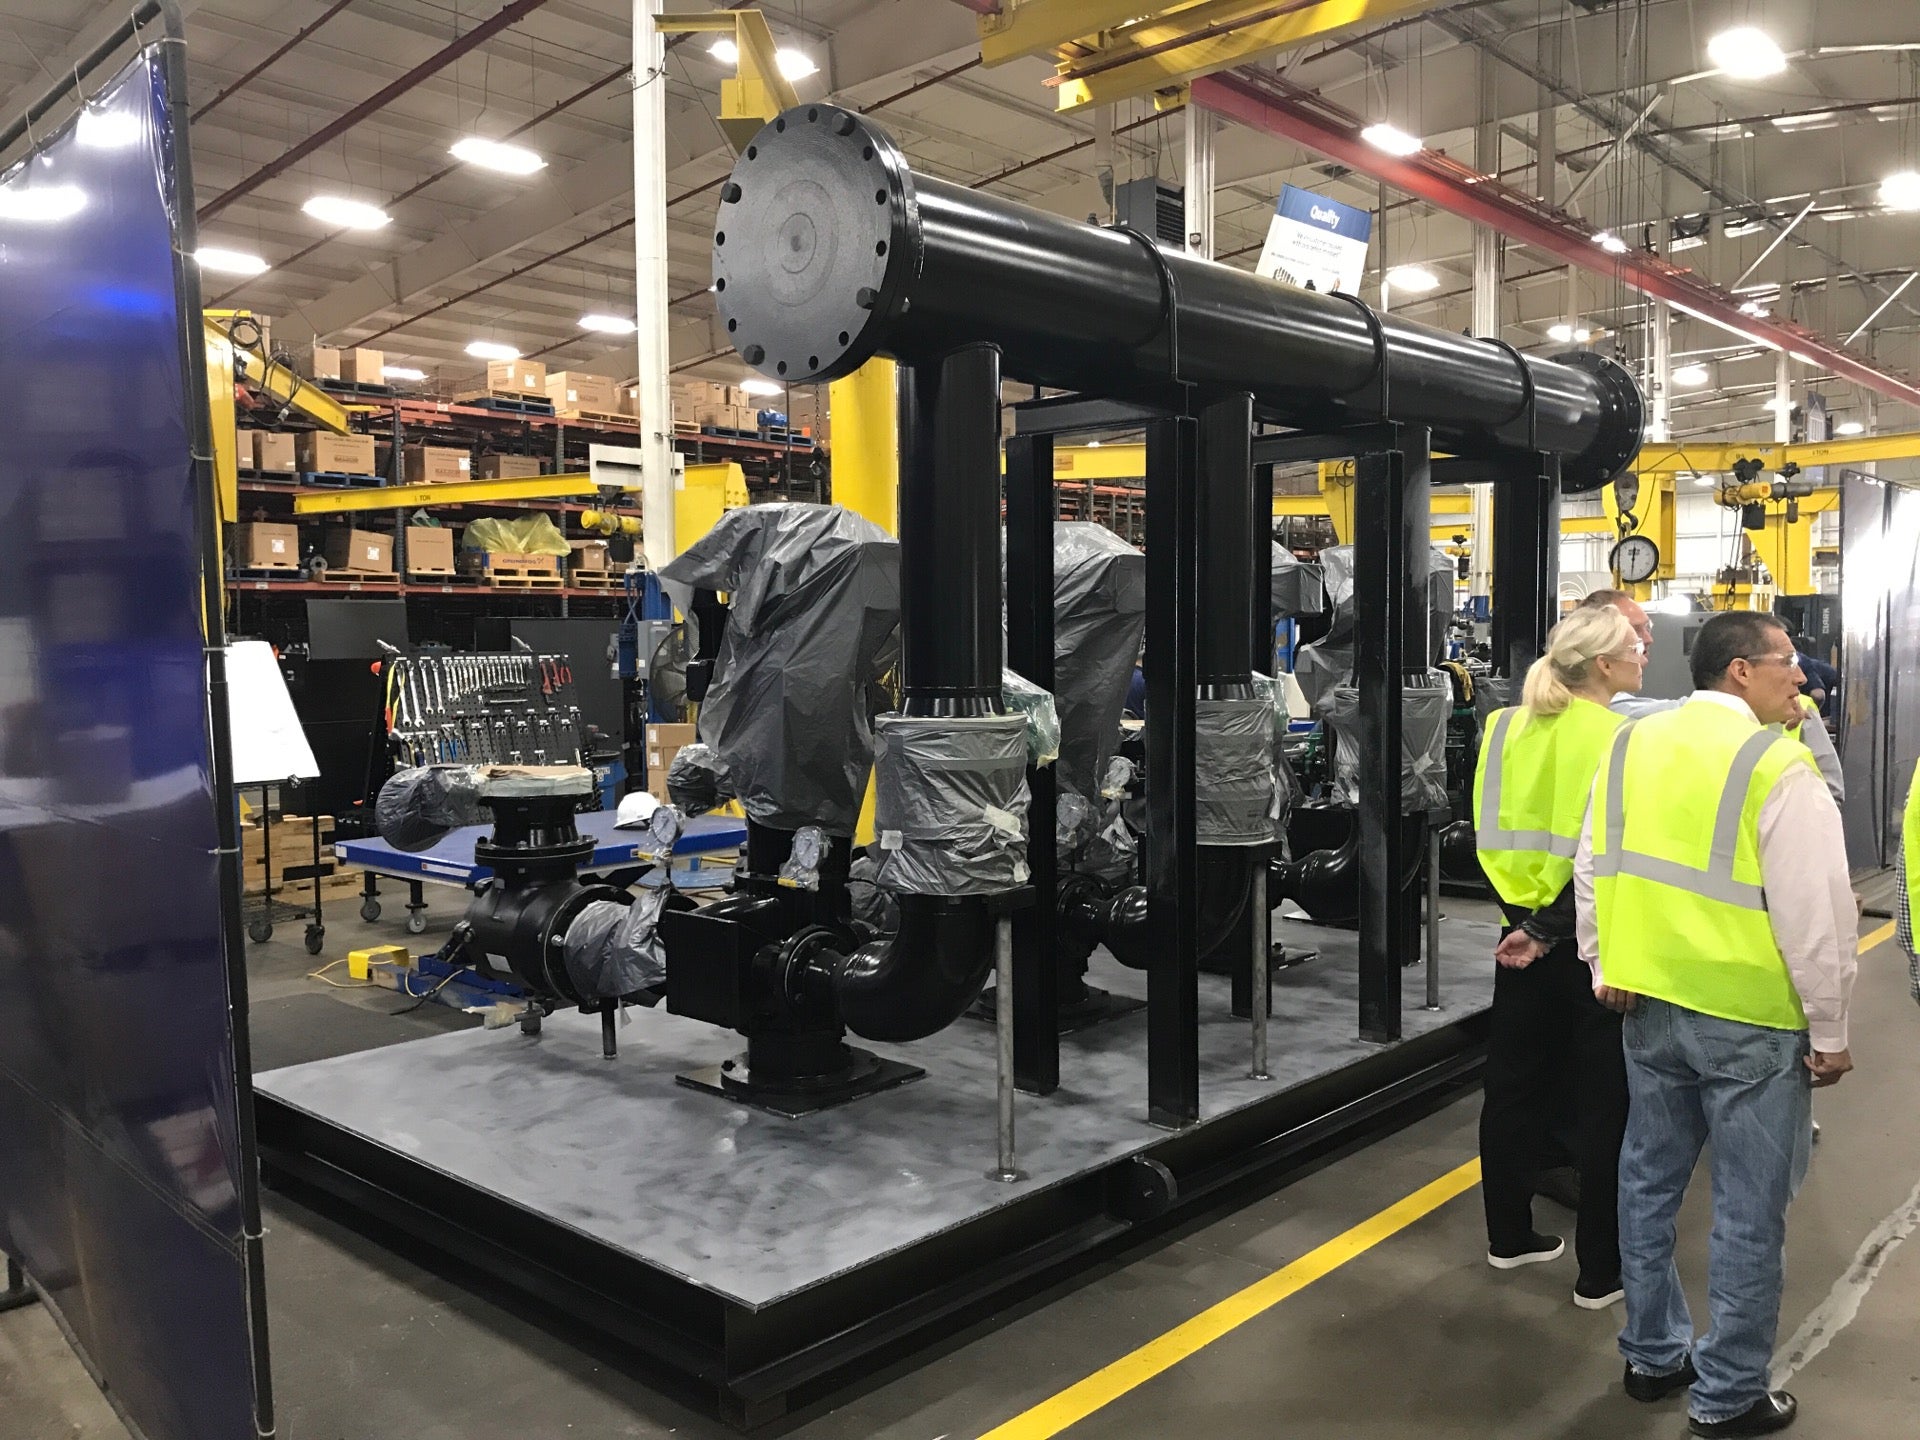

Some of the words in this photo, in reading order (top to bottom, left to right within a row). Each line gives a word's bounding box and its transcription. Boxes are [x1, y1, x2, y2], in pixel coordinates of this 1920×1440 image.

[1310, 205, 1340, 229] Quality
[419, 494, 431, 502] TON
[1822, 607, 1830, 634] CLARK
